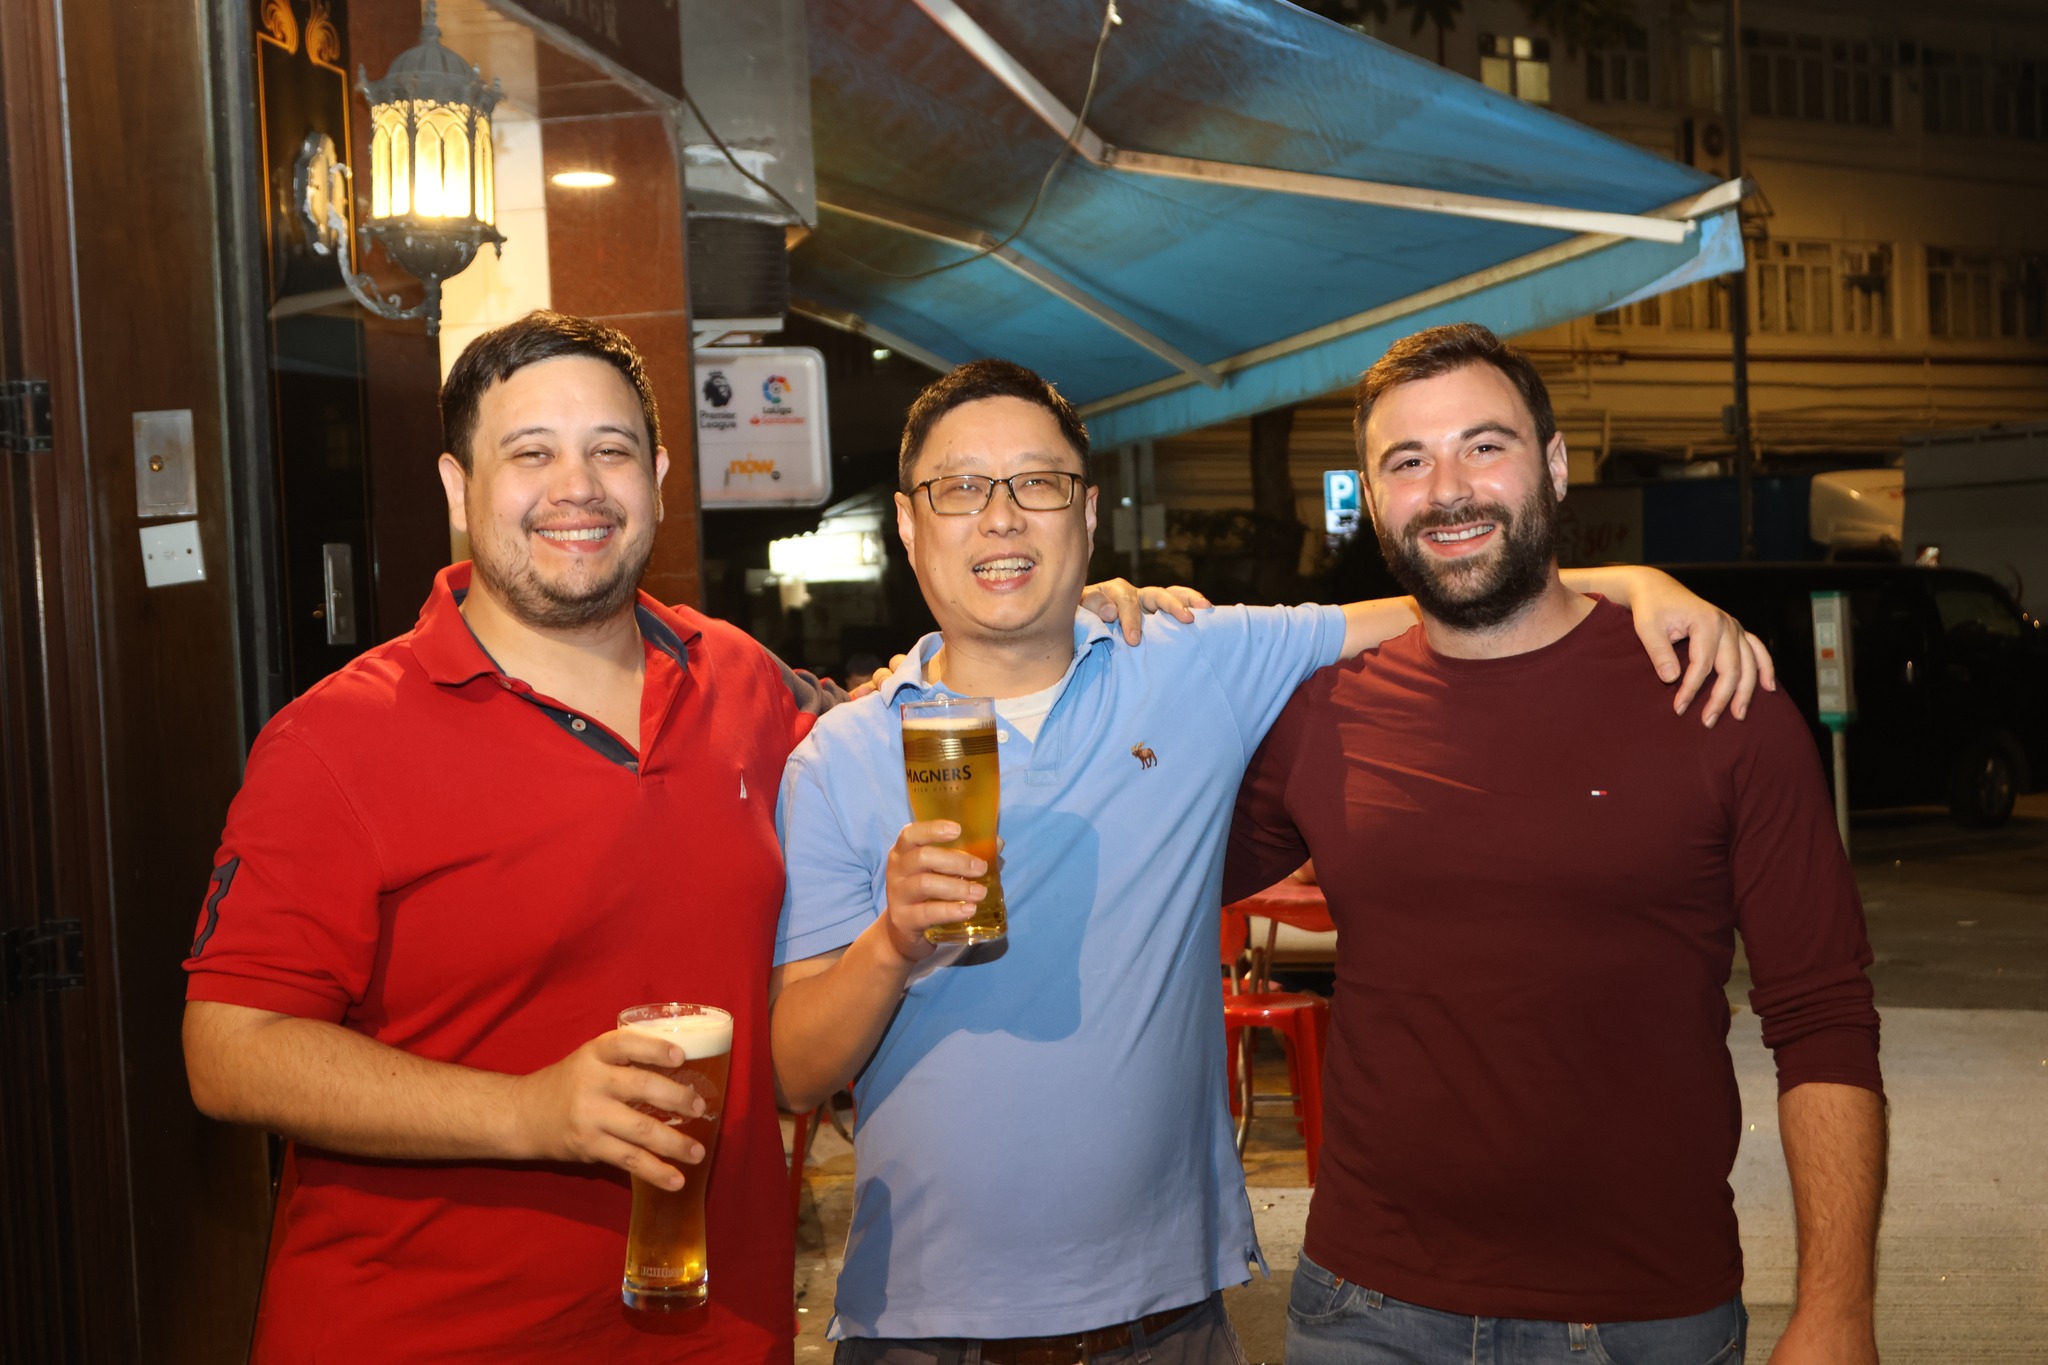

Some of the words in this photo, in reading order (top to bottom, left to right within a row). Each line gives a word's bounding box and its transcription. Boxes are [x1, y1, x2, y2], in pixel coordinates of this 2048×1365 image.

[699, 410, 736, 420] Premier
[699, 419, 737, 431] League
[730, 456, 775, 479] now
[1330, 474, 1354, 510] P
[905, 765, 972, 783] MAGNERS
